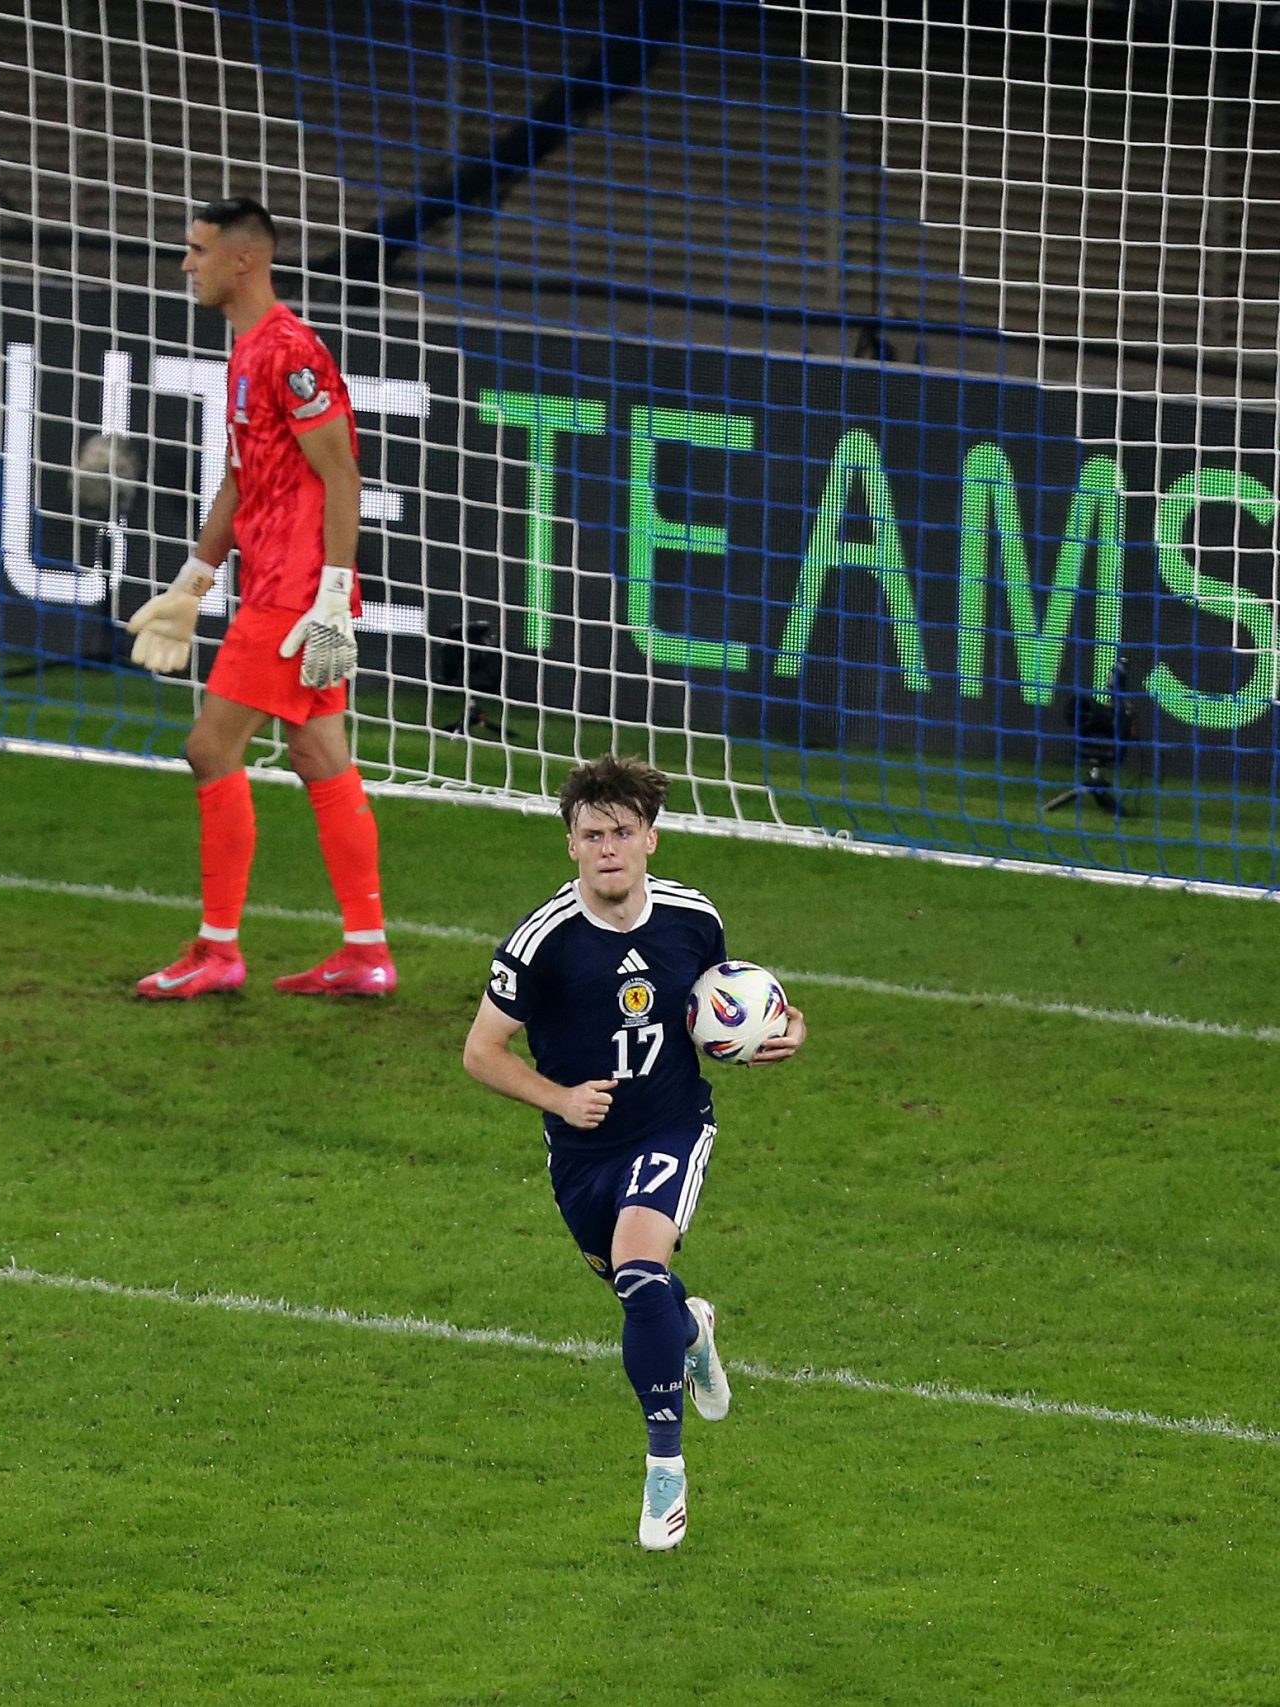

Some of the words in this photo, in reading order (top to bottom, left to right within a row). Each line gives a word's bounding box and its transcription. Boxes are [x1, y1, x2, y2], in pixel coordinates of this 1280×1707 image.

[478, 388, 1280, 729] TEAMS
[611, 1022, 665, 1079] 17
[625, 1152, 679, 1197] 17
